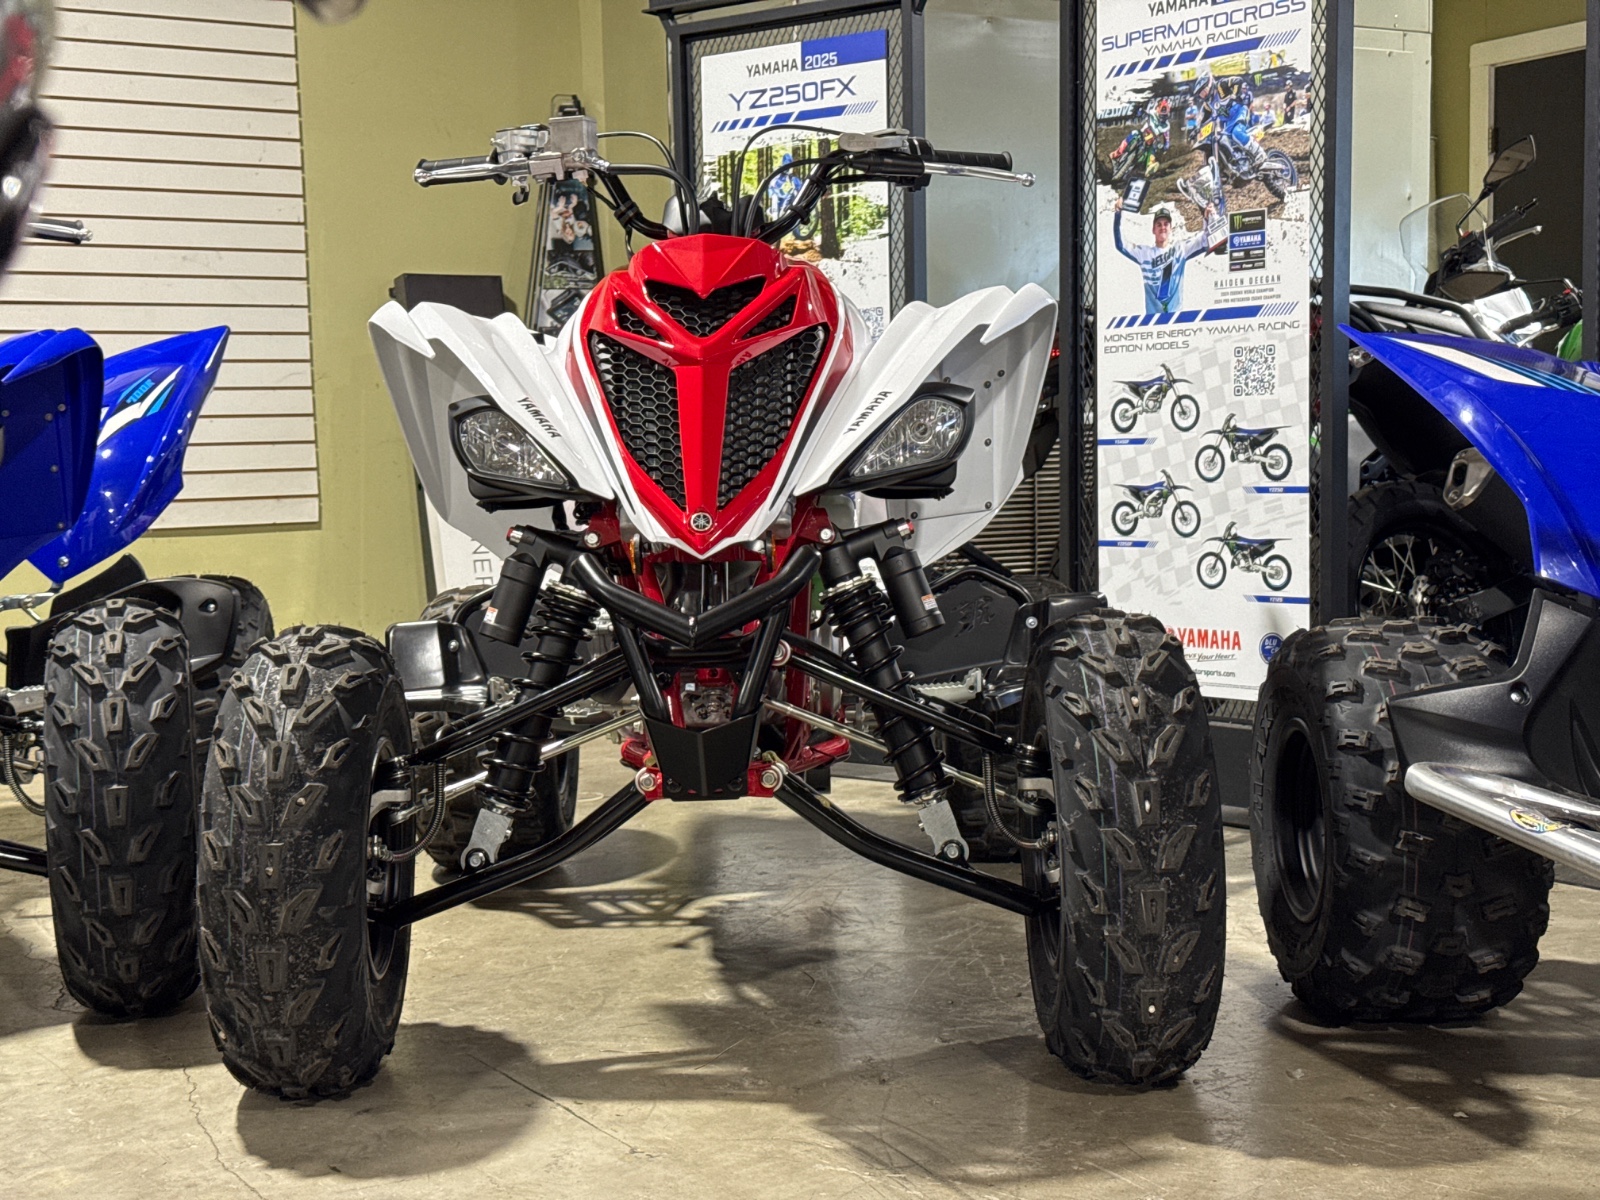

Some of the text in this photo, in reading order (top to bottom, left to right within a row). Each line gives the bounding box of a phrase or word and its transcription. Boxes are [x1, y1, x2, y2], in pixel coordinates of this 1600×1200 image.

[1101, 0, 1306, 52] SUPERMOTOCROSS
[1144, 24, 1258, 56] YAMAHA RACING
[746, 52, 838, 77] YAMAHA 2025
[729, 75, 857, 112] YZ250FX
[1240, 234, 1262, 243] YAMAHA
[1214, 274, 1281, 288] HAIDEN DEEGAN
[1104, 332, 1154, 343] MONSTER
[1206, 324, 1255, 335] YAMAHA
[1258, 320, 1300, 331] RACING
[1104, 340, 1190, 354] EDITION MODELS
[517, 396, 562, 438] YAMAHA
[843, 391, 893, 435] YAMAHA
[1177, 627, 1241, 651] YAMAHA
[1264, 638, 1277, 646] BLU
[1197, 652, 1214, 662] Your
[1215, 652, 1235, 660] Heart
[1194, 668, 1236, 677] torsports.com
